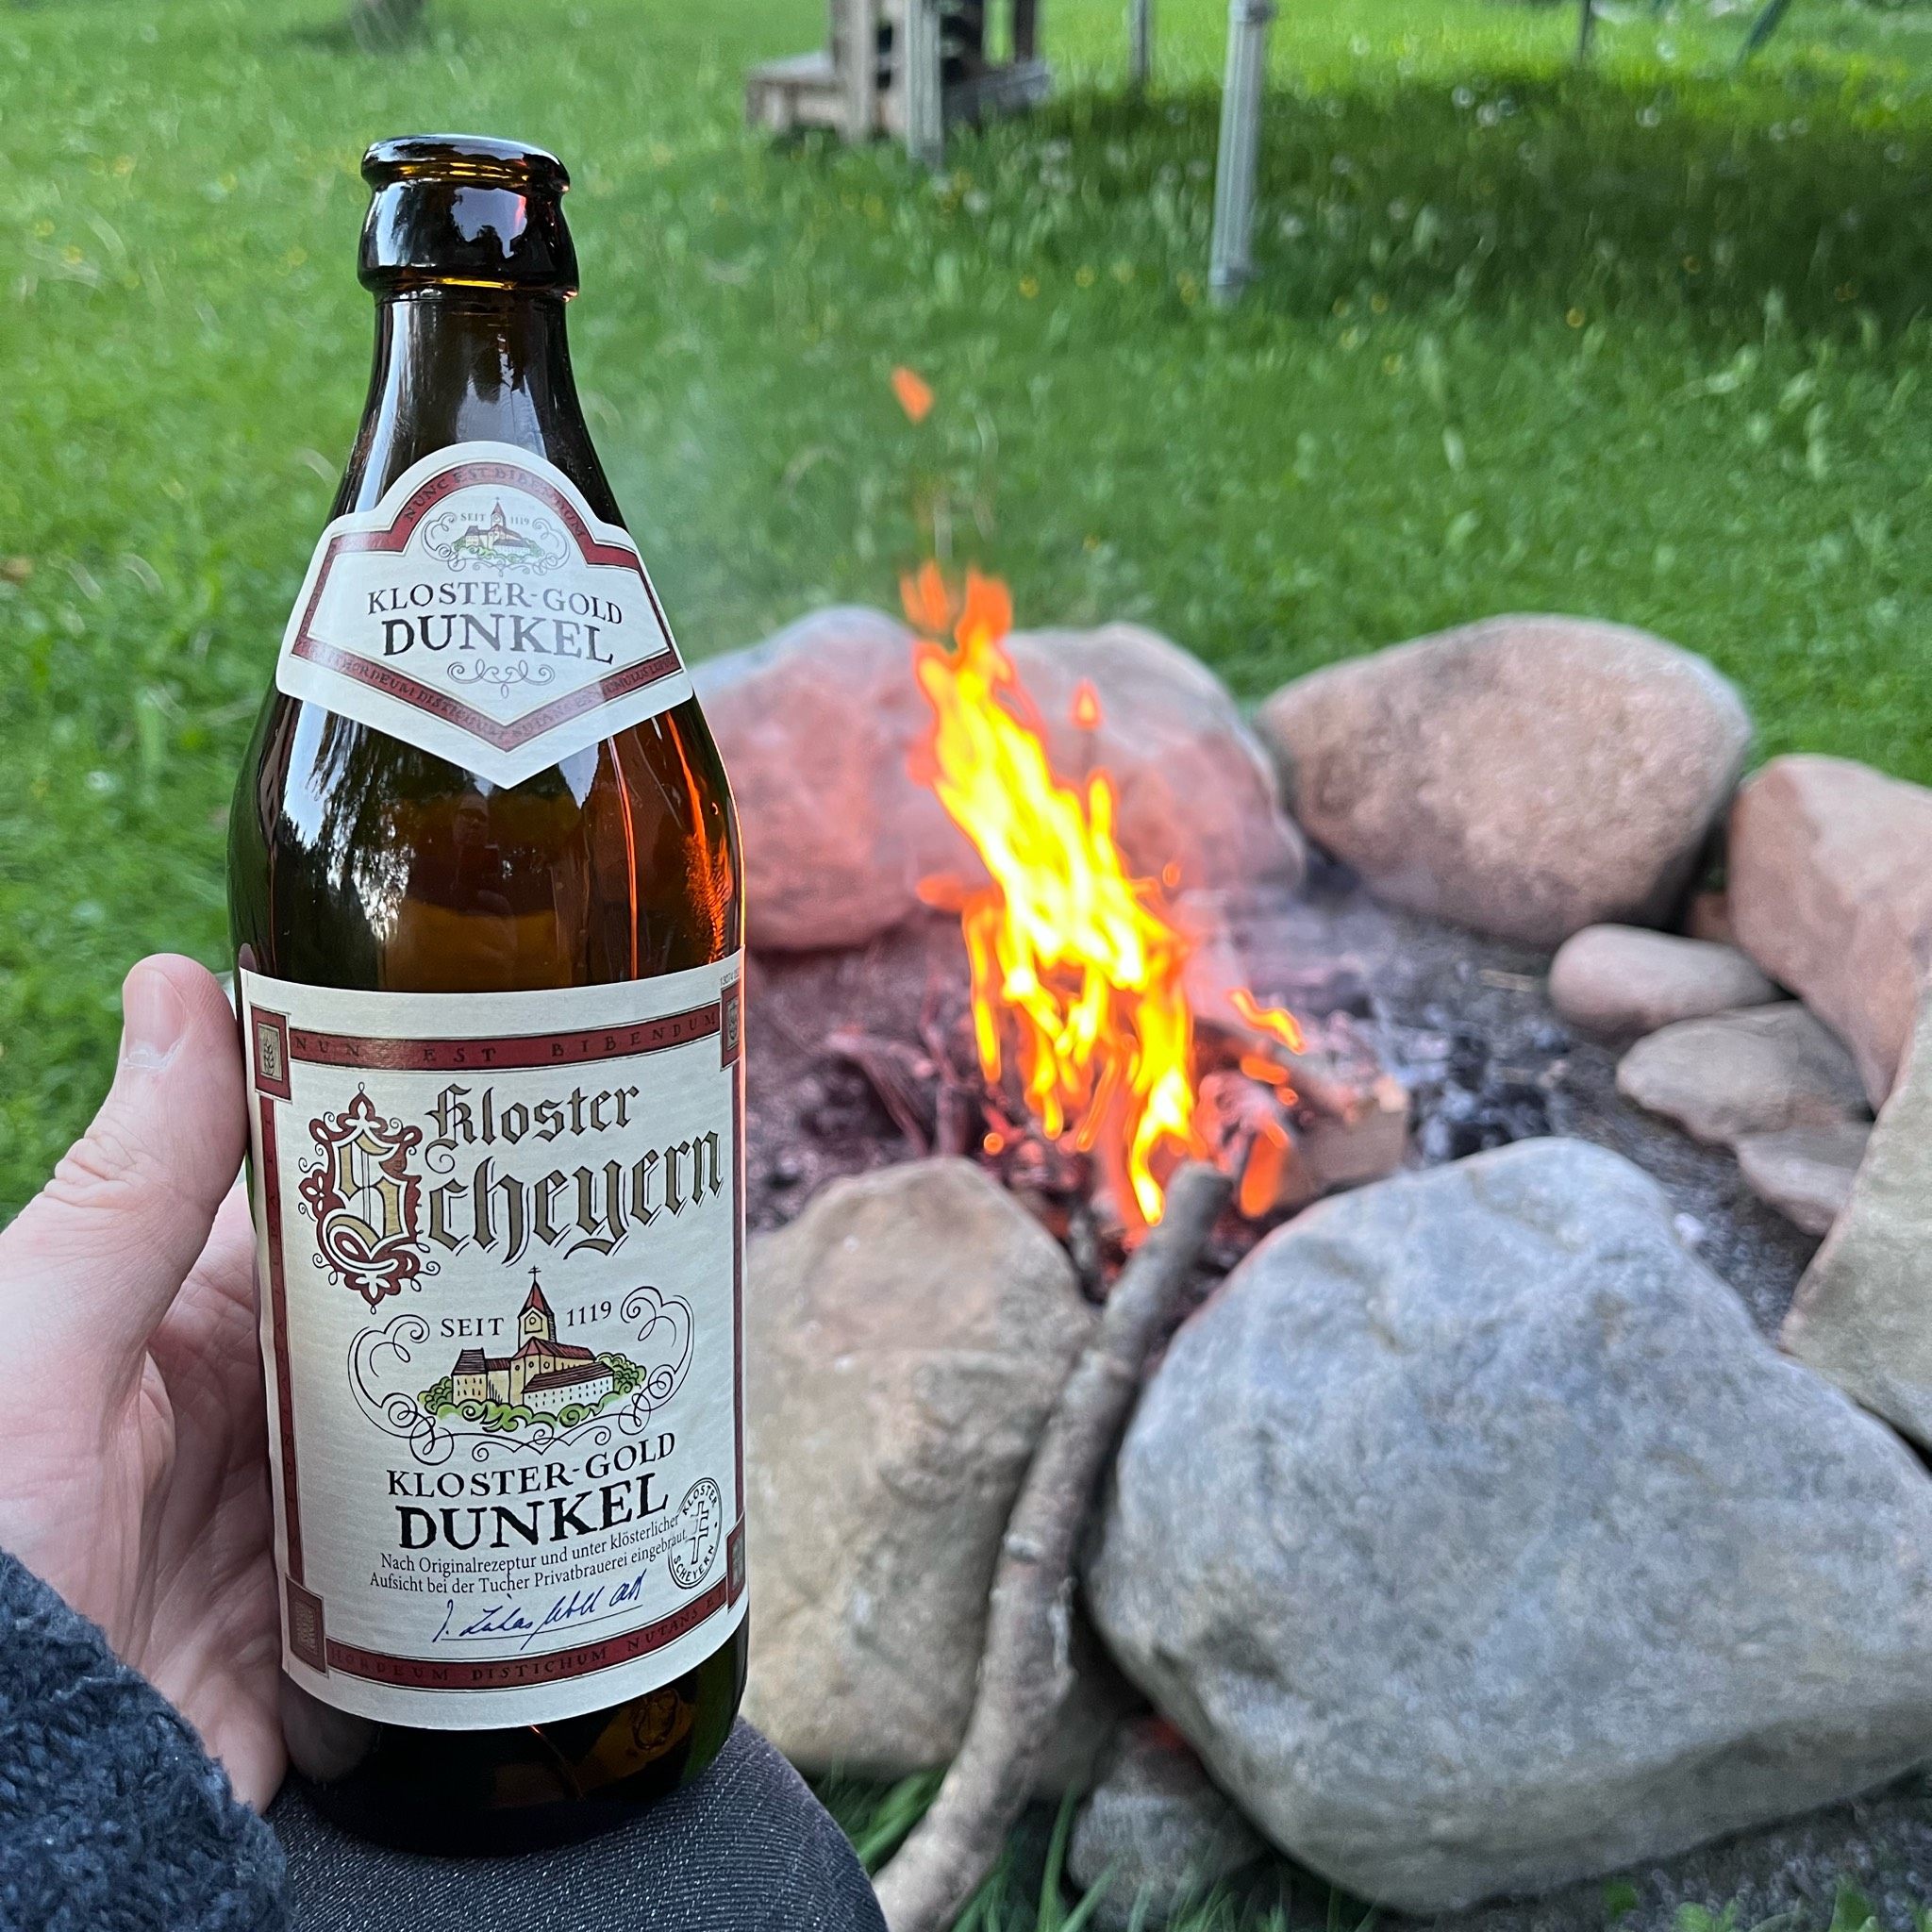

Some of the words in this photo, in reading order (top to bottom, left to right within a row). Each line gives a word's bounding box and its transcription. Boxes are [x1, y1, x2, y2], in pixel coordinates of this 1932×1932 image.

[404, 478, 449, 523] NUNC
[460, 513, 486, 522] SEIT
[367, 581, 623, 625] KLOSTER-GOLD
[381, 613, 614, 665] DUNKEL
[424, 1048, 496, 1063] EST
[552, 1012, 715, 1058] BIBENDUM
[425, 1083, 641, 1174] Kloster
[321, 1130, 724, 1266] Scheyern
[441, 1318, 505, 1338] SEIT
[566, 1301, 612, 1327] 1119
[387, 1432, 676, 1499] KLOSTER-GOLD
[395, 1472, 669, 1551] DUNKEL
[682, 1485, 718, 1515] KLOSTER
[380, 1552, 415, 1572] Nach
[419, 1556, 537, 1578] Originalrezeptur
[541, 1547, 567, 1565] und
[572, 1541, 608, 1560] unter
[610, 1514, 679, 1551] klösterlicher
[674, 1544, 714, 1582] SCHEYERN
[370, 1572, 424, 1592] Aufsicht
[427, 1576, 447, 1593] bei
[452, 1577, 475, 1593] der
[478, 1574, 530, 1593] Tucher
[535, 1552, 627, 1588] Privatbrauerei
[472, 1647, 608, 1681] DISTICHUM
[626, 1609, 698, 1651] NUTANS
